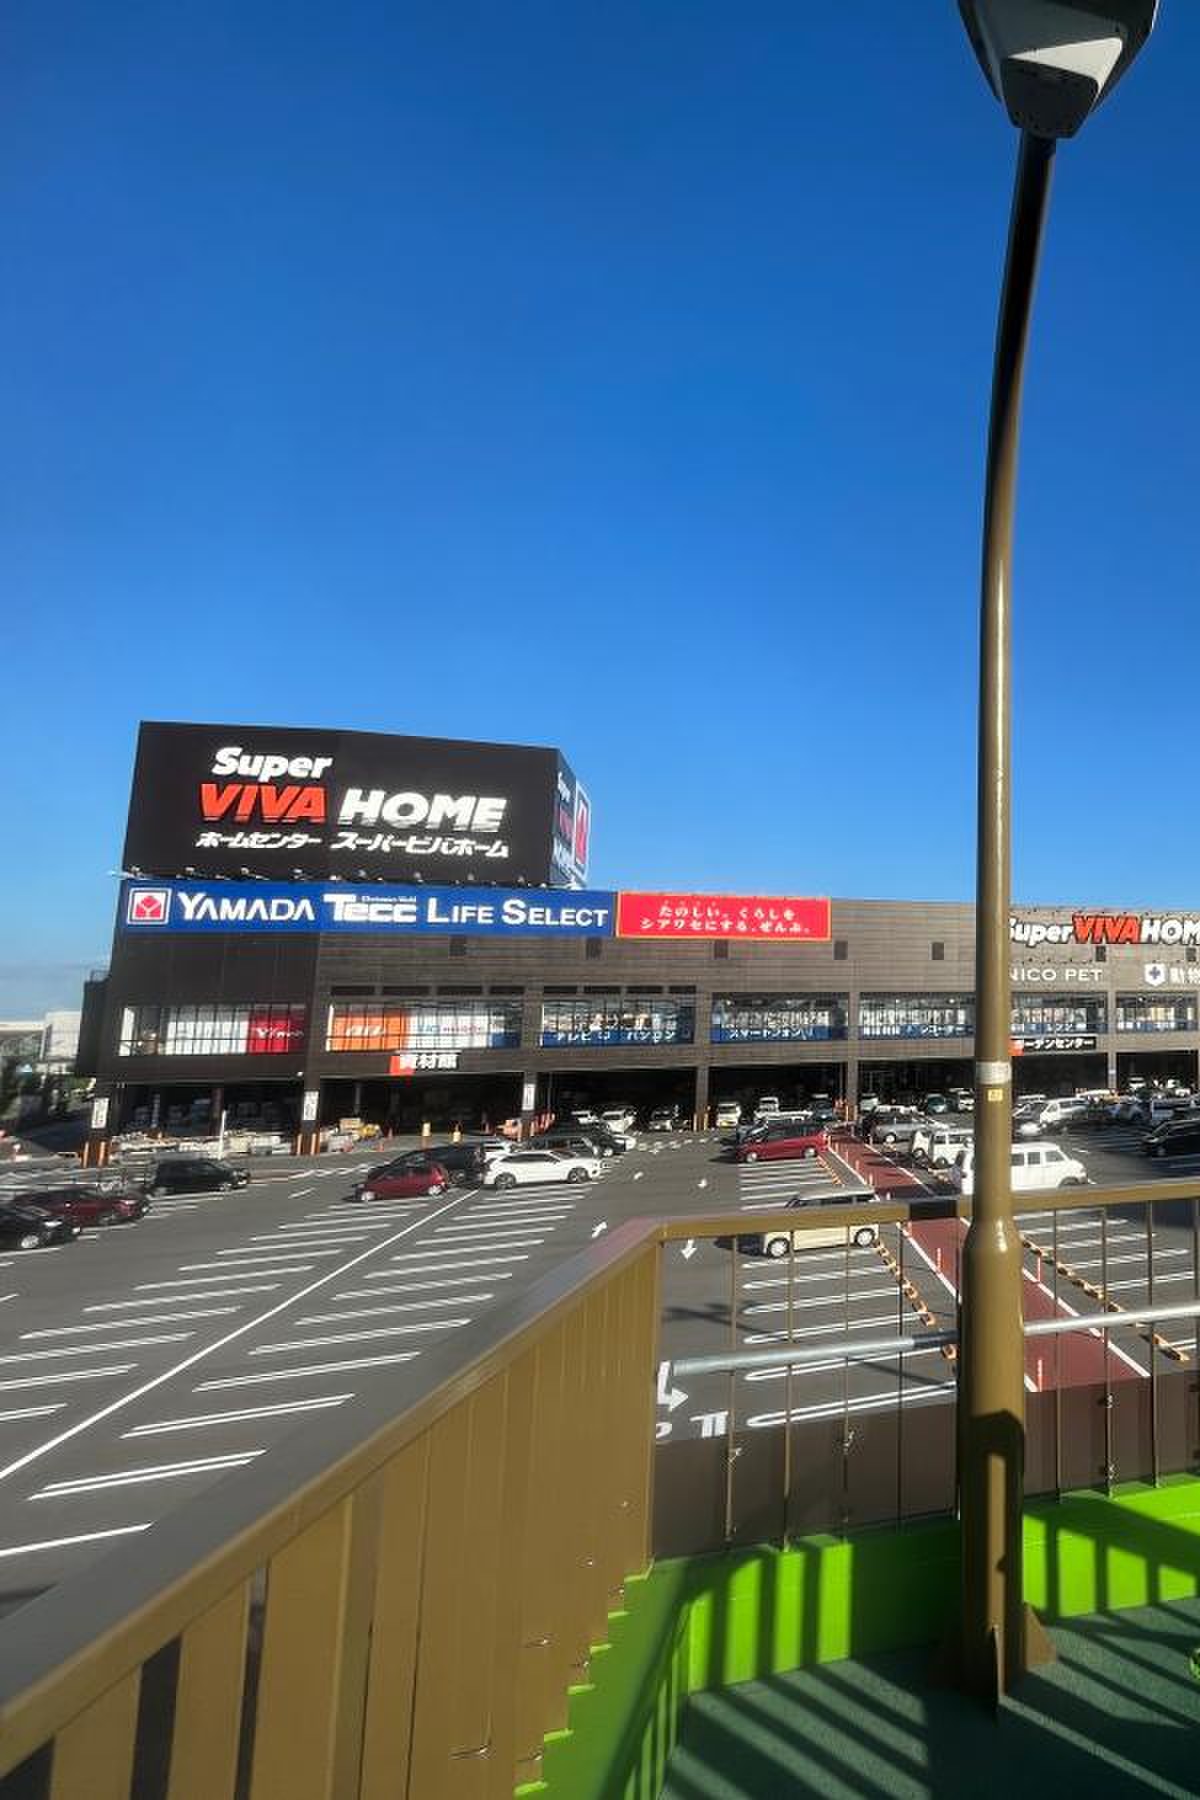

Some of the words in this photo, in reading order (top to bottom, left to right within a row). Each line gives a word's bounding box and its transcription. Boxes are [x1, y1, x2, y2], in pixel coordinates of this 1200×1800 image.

[212, 747, 333, 782] Super
[201, 783, 325, 823] VIVA
[337, 788, 507, 832] HOME
[195, 831, 322, 848] ホームセンター
[330, 832, 508, 858] スーパービバホーム
[177, 892, 315, 921] YAMADA
[427, 897, 494, 924] LIFE
[501, 899, 608, 927] SELECT
[1065, 969, 1103, 982] PET
